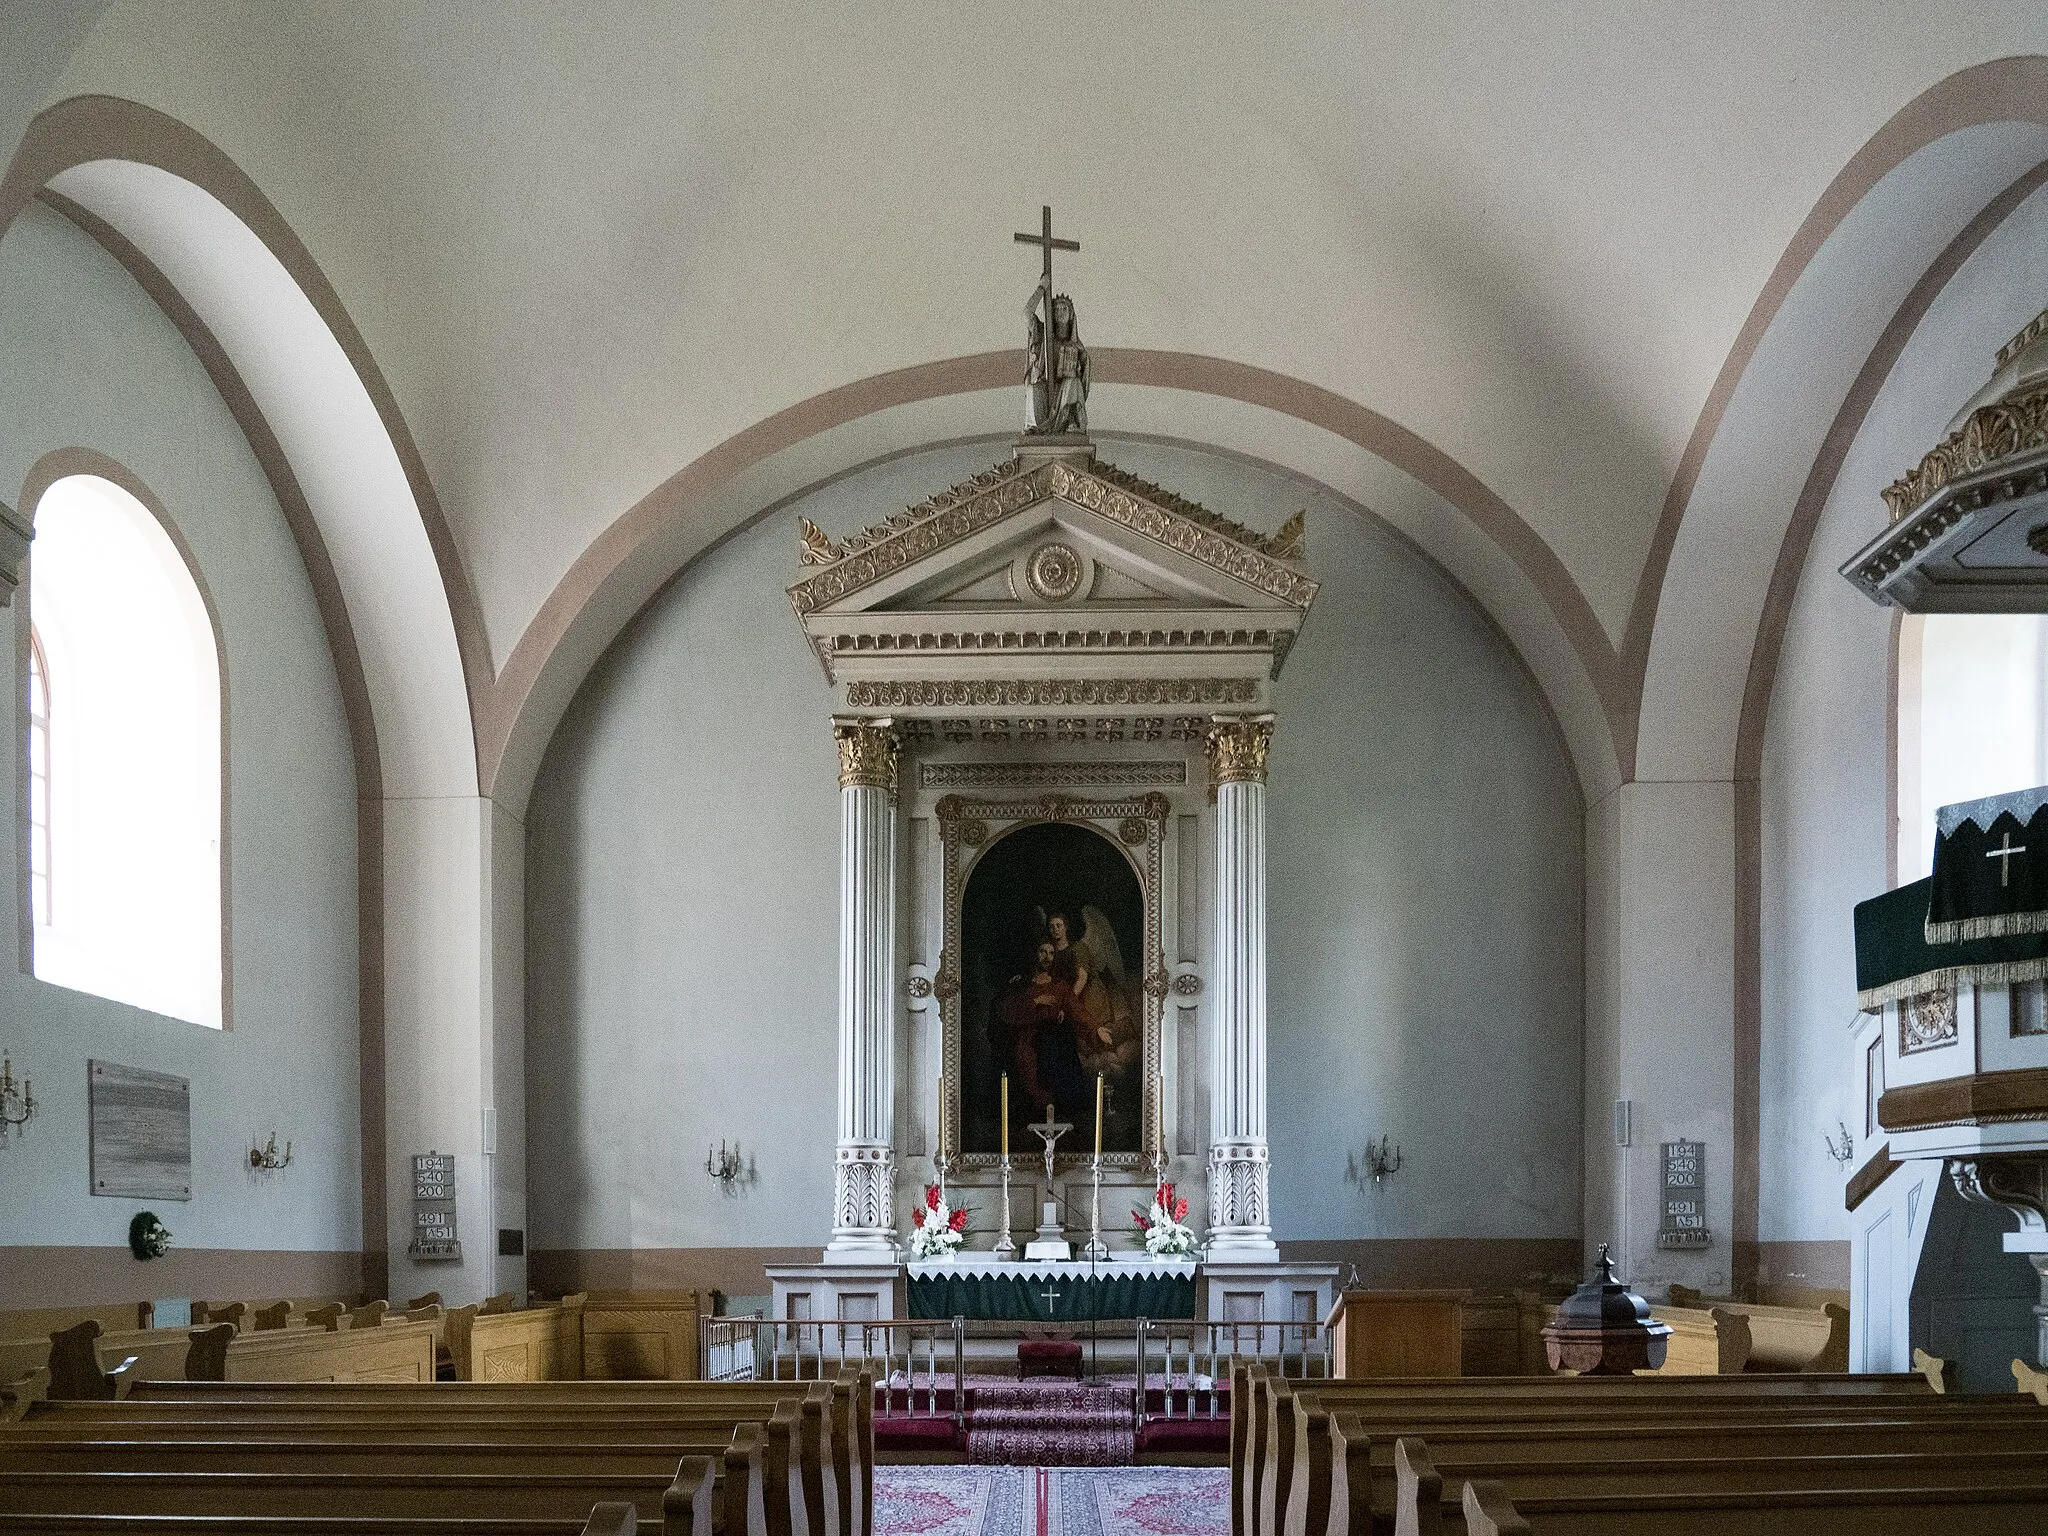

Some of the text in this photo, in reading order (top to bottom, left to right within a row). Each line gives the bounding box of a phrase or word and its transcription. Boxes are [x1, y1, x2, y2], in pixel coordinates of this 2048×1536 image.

[1670, 1145, 1695, 1157] 194
[420, 1158, 443, 1170] 194
[1669, 1159, 1695, 1171] 540
[418, 1171, 443, 1183] 540
[1668, 1173, 1694, 1185] 200
[419, 1186, 443, 1197] 200
[1669, 1202, 1693, 1213] 491
[419, 1213, 442, 1224] 491
